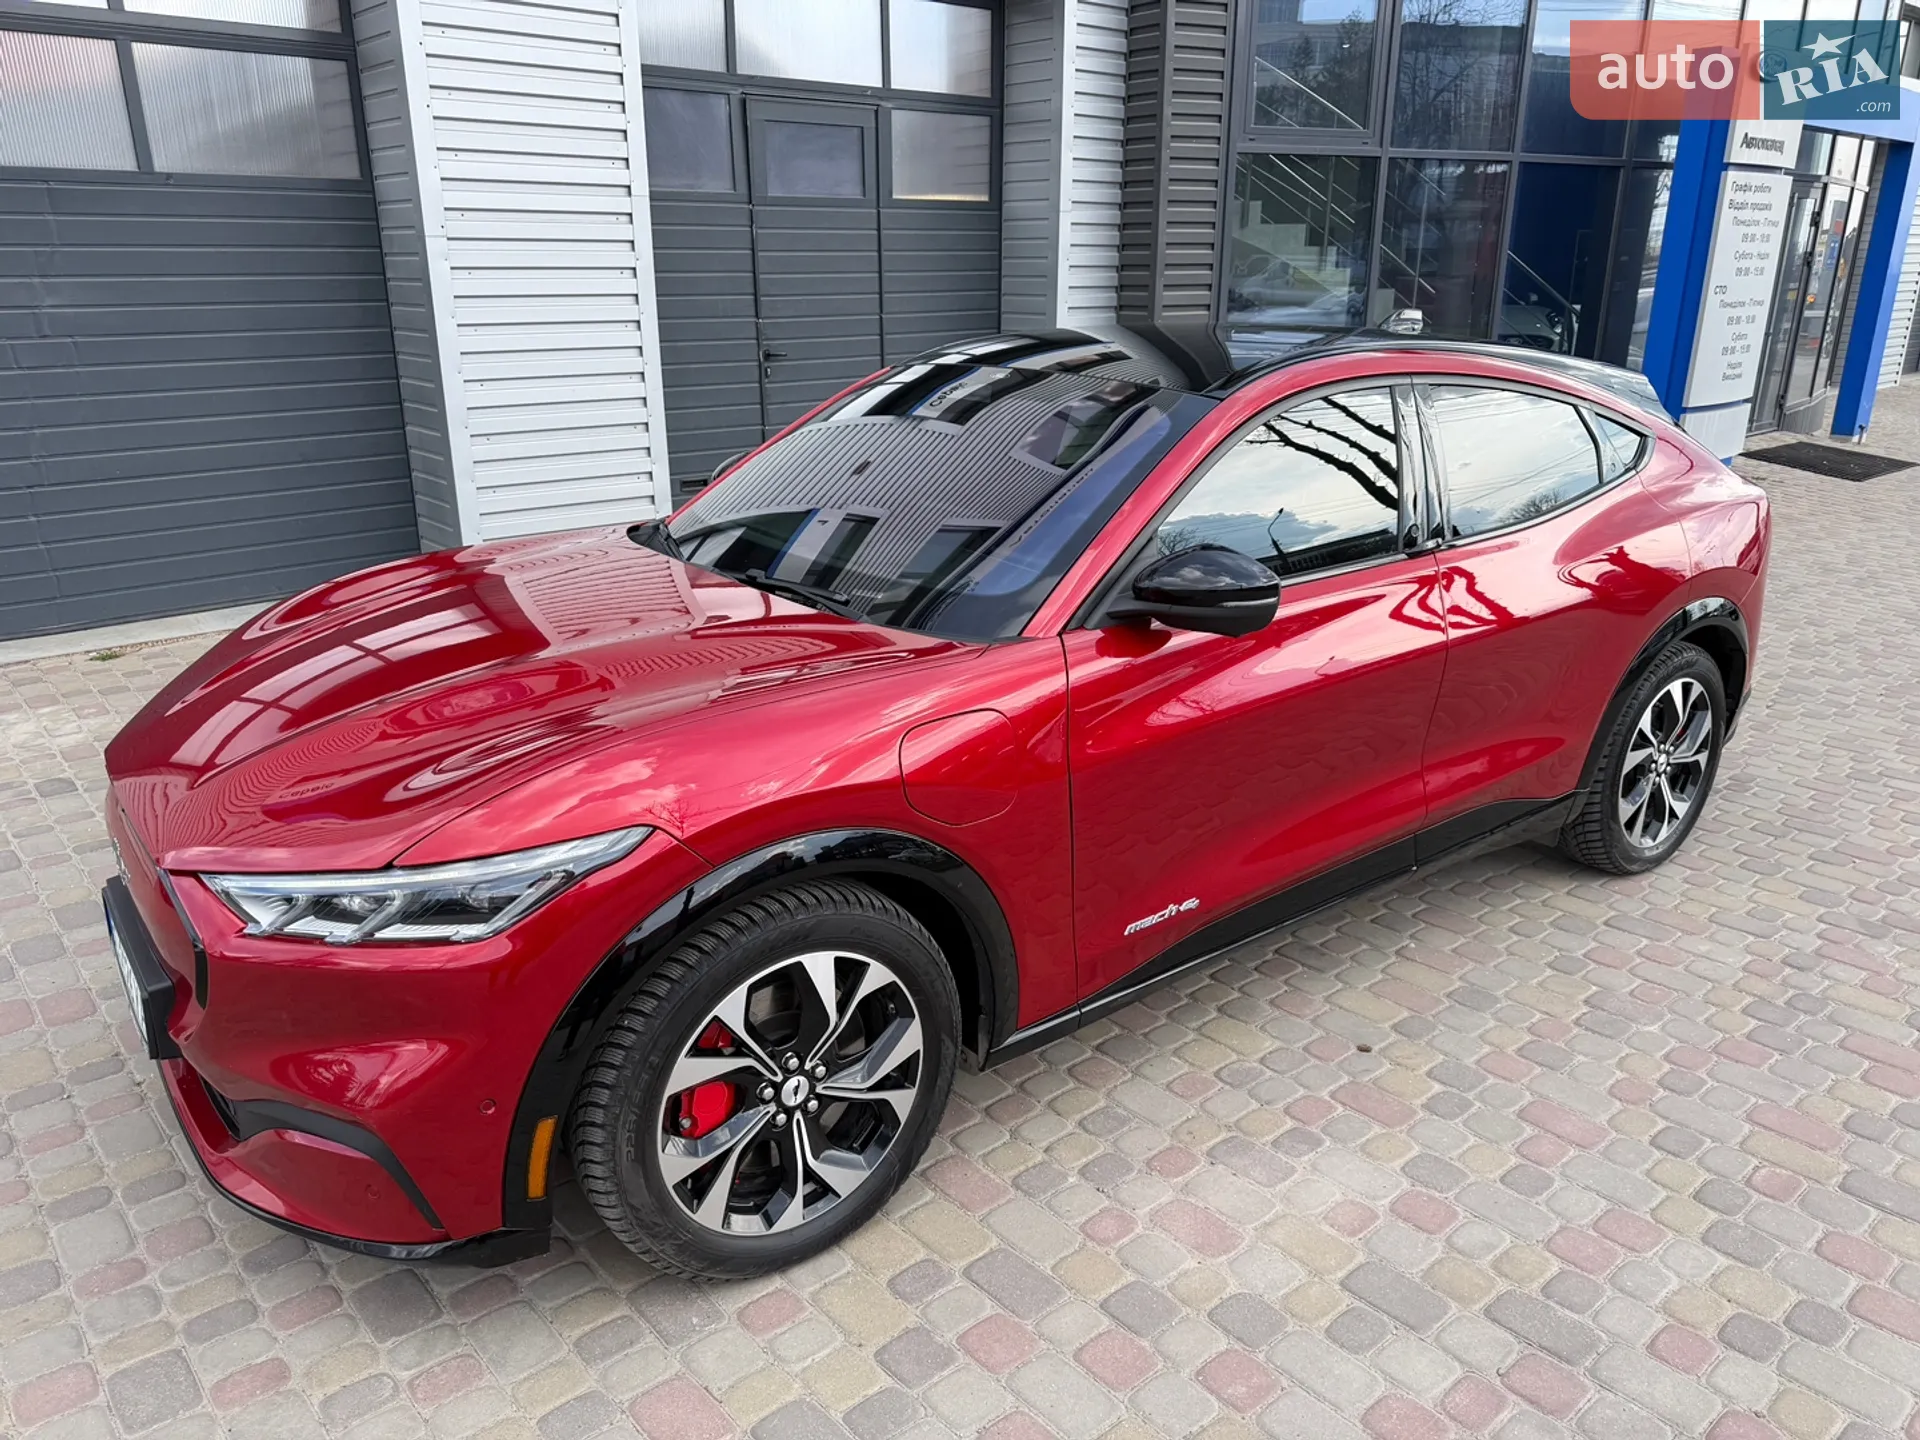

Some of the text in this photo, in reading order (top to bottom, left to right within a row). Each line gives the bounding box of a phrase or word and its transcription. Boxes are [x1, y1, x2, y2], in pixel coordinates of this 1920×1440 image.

[1731, 181, 1752, 194] Графік
[1728, 199, 1748, 211] Відділ
[1714, 285, 1728, 295] СТО
